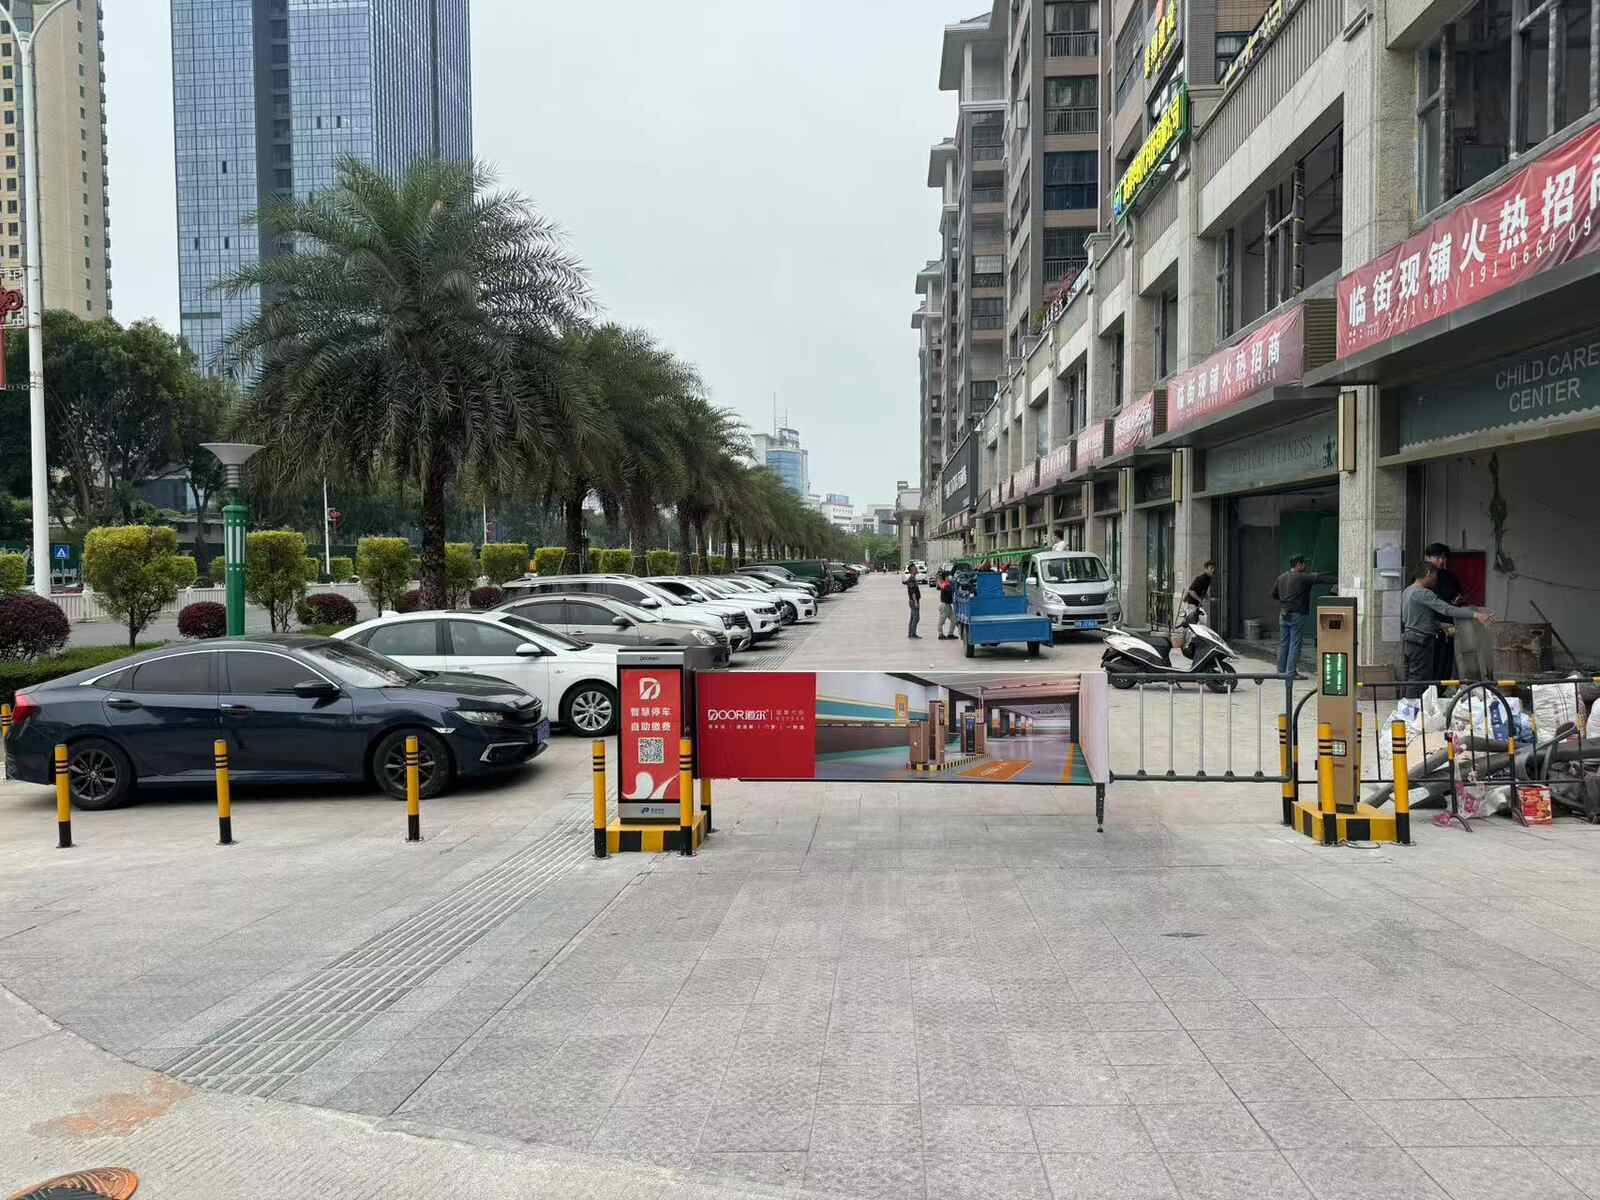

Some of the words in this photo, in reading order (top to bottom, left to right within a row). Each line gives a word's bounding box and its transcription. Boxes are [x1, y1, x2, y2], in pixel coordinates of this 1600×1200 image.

[1349, 153, 1600, 327] 临街现铺火热招
[1495, 360, 1543, 390] CHILD
[1548, 342, 1600, 376] CARE
[1509, 378, 1580, 412] CENTER
